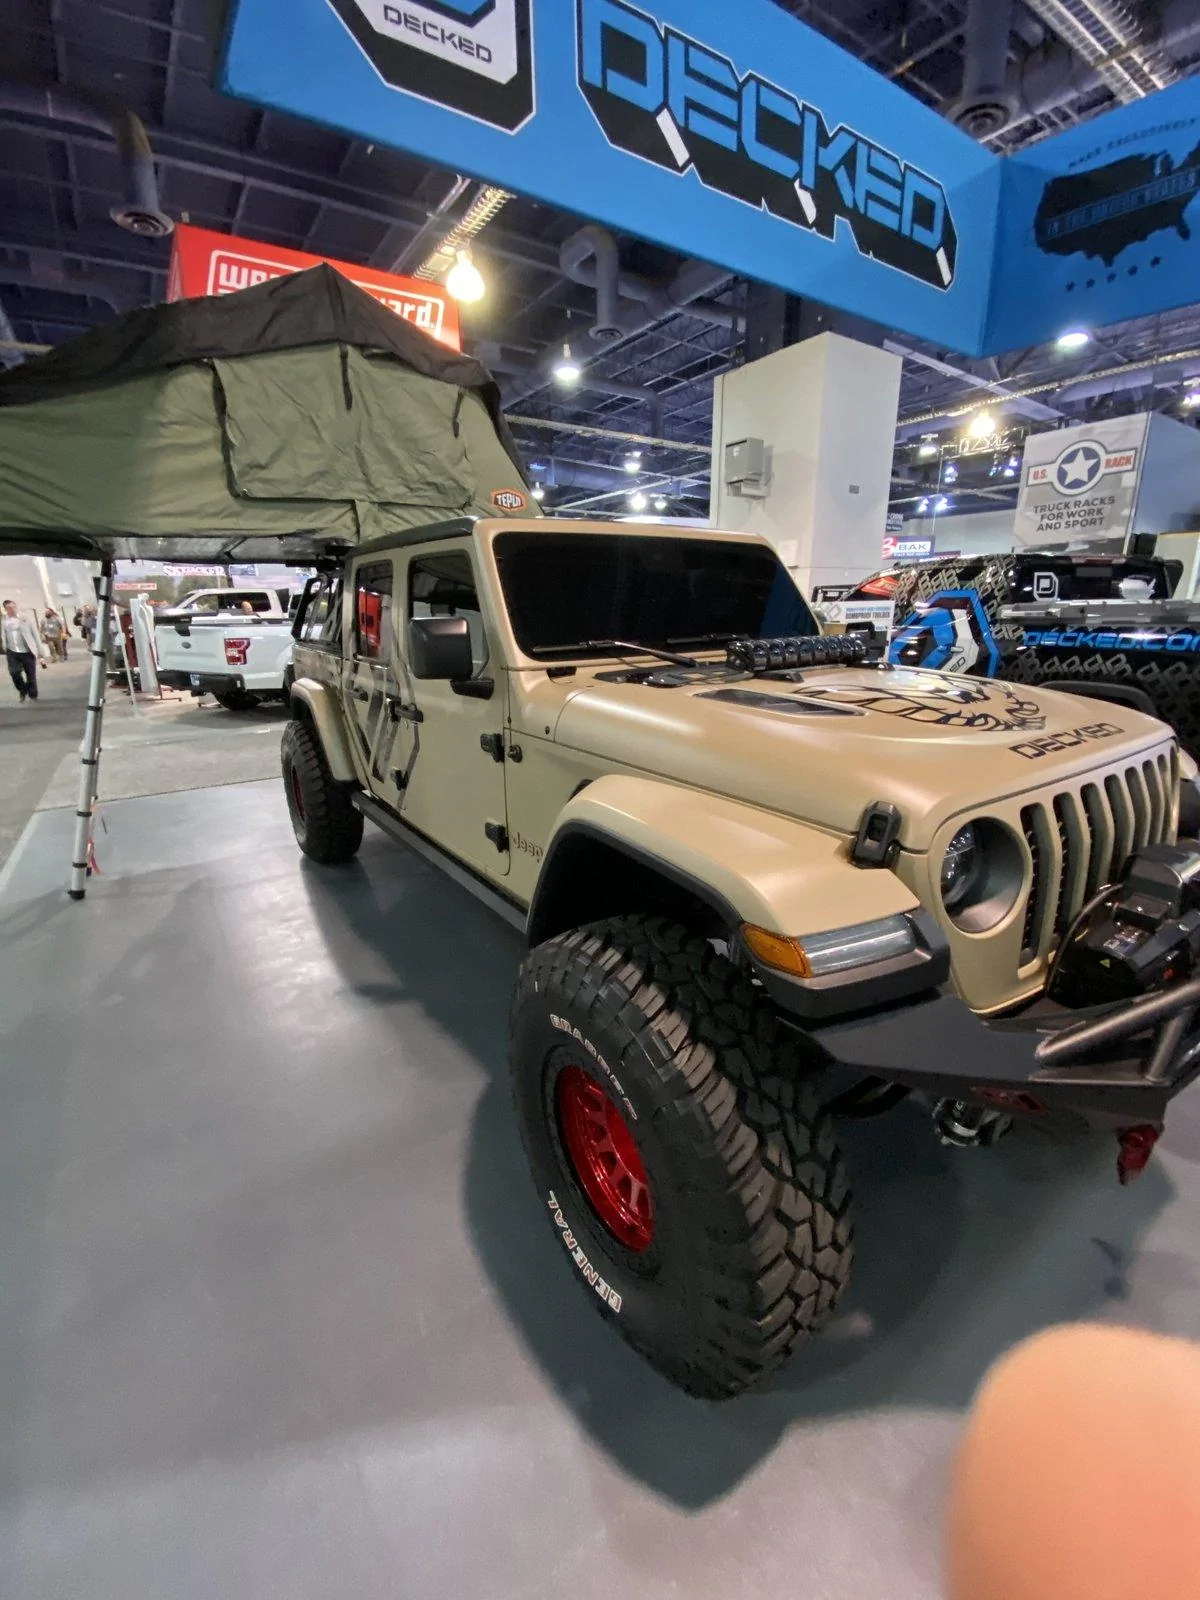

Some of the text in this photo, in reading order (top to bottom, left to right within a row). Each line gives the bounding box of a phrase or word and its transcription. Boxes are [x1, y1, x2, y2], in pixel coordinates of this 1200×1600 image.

[383, 4, 492, 64] DECKED
[574, 0, 947, 254] DECKED
[1032, 455, 1133, 481] U.S. RACK
[1034, 496, 1116, 514] TRUCK RACKS
[1041, 507, 1104, 522] FOR WORK
[1036, 517, 1104, 532] AND SPORT
[1023, 631, 1200, 651] DECKED.CO
[1008, 722, 1125, 760] DECKED
[512, 832, 543, 864] Jeep
[547, 1189, 622, 1313] GENERAL
